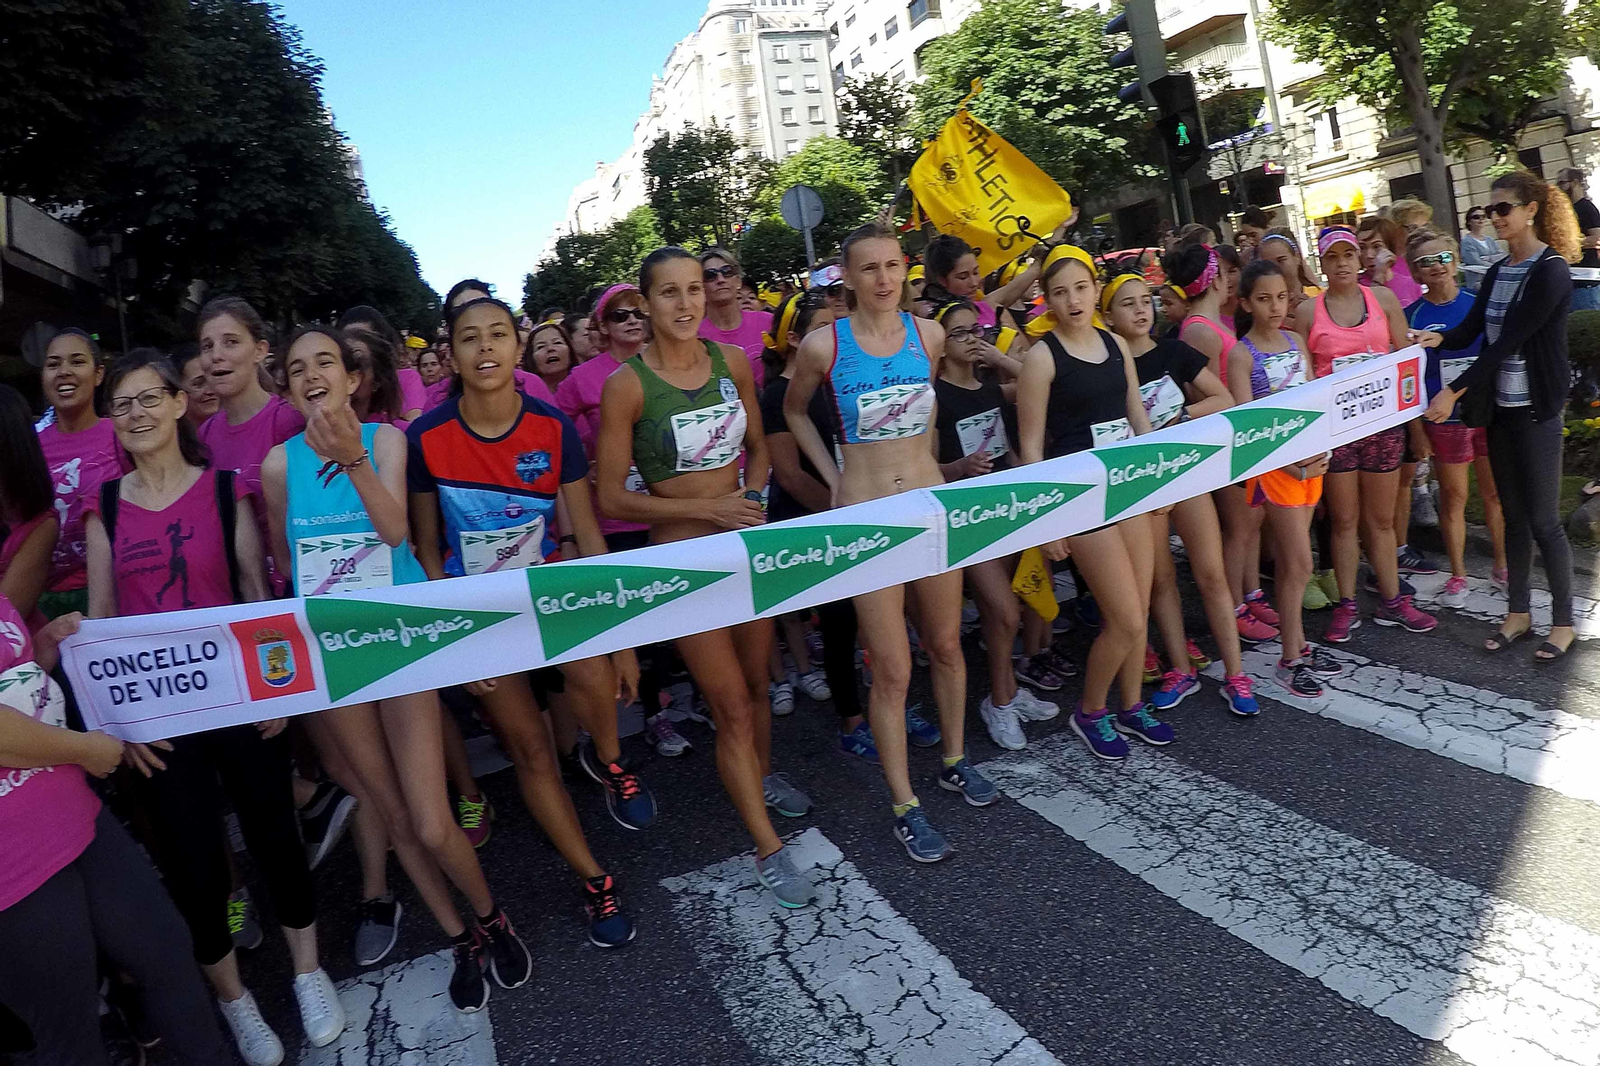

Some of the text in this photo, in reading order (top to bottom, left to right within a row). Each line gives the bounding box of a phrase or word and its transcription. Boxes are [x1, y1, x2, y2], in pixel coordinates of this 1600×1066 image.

[1334, 377, 1391, 405] CONCELLO
[1342, 395, 1385, 420] DE VIGO
[949, 508, 969, 529] El
[968, 503, 1009, 524] Corte
[330, 557, 356, 575] 223
[751, 531, 891, 574] El Corte Inglés
[536, 575, 690, 615] El Corte Inglés
[318, 615, 474, 652] El Corte Inglés
[88, 640, 218, 681] CONCELLO
[109, 670, 208, 706] DE VIGO
